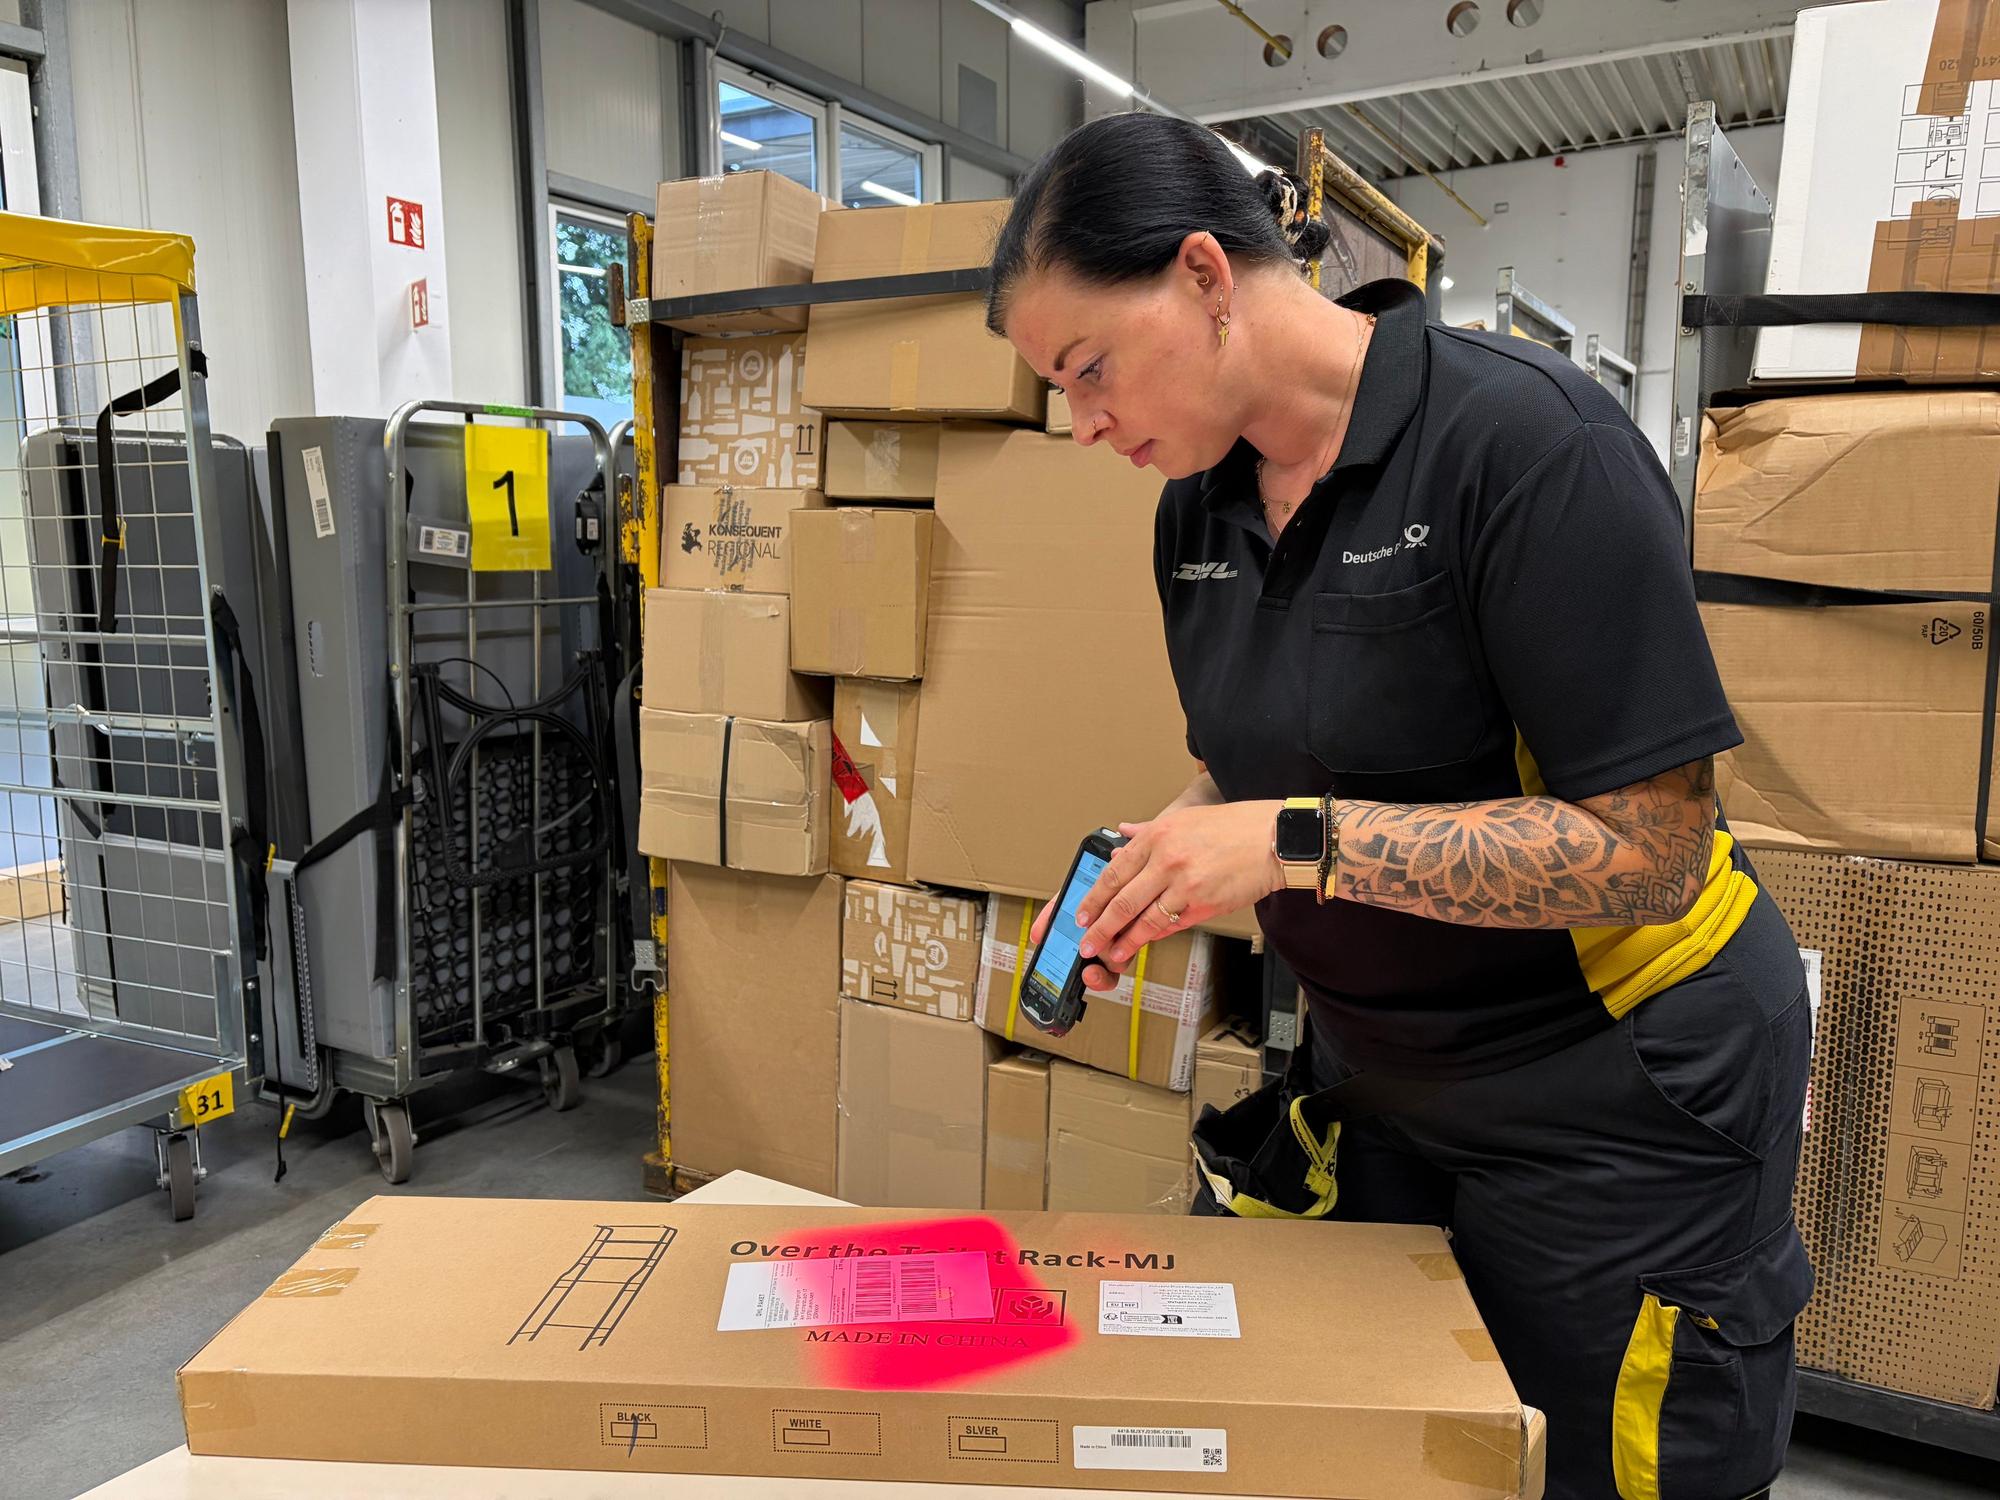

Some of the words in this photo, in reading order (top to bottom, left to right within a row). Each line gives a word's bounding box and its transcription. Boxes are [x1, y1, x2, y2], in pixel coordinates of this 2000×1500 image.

[493, 470, 519, 537] 1
[708, 524, 782, 538] KONSEQUENT
[707, 540, 781, 559] REGIONAL
[1342, 545, 1393, 564] Deutsche
[1172, 561, 1238, 581] DHL
[1939, 625, 1949, 637] 20
[1972, 611, 1985, 649] 60/50B
[197, 1089, 225, 1116] 31
[730, 1240, 819, 1258] Over
[828, 1243, 888, 1258] the
[1018, 1249, 1176, 1270] Rack-MJ
[804, 1330, 893, 1344] MADE
[899, 1333, 929, 1345] IN
[936, 1334, 1029, 1348] CHINA
[616, 1412, 652, 1422] BLACK
[789, 1418, 823, 1429] WHITE
[965, 1425, 999, 1436] SLVER
